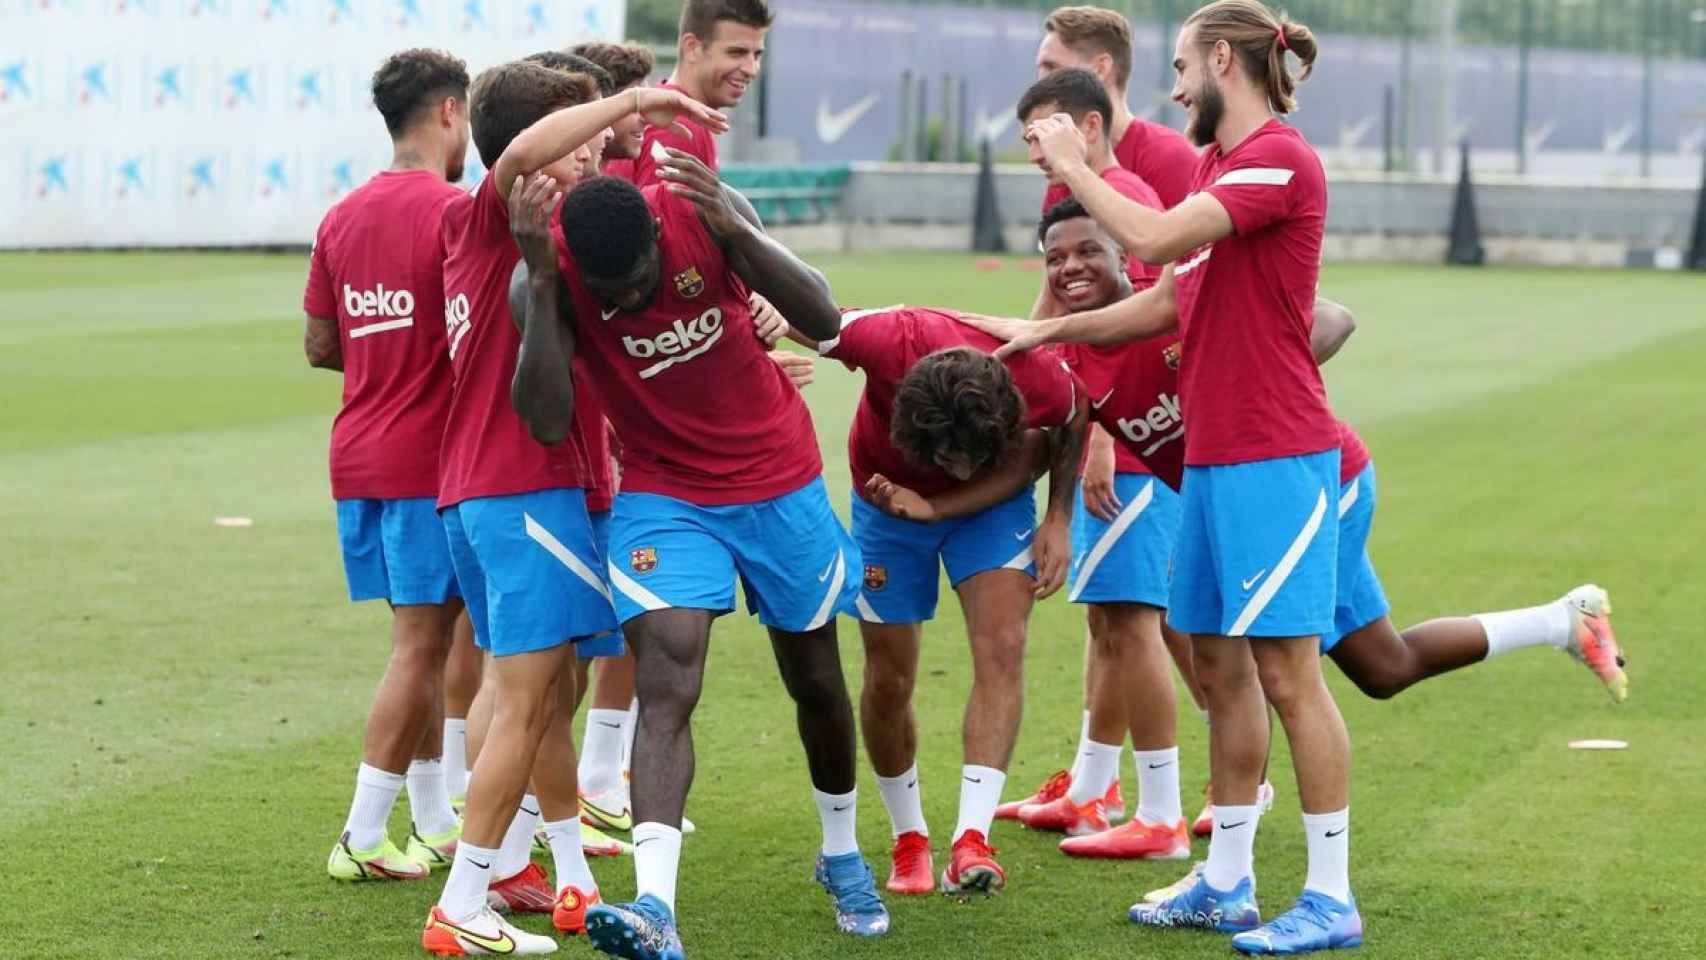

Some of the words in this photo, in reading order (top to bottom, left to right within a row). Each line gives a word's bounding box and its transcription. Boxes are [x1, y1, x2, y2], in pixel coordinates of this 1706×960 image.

[343, 283, 415, 317] beko
[445, 292, 470, 336] ko
[622, 307, 722, 358] beko
[1117, 393, 1182, 442] bek
